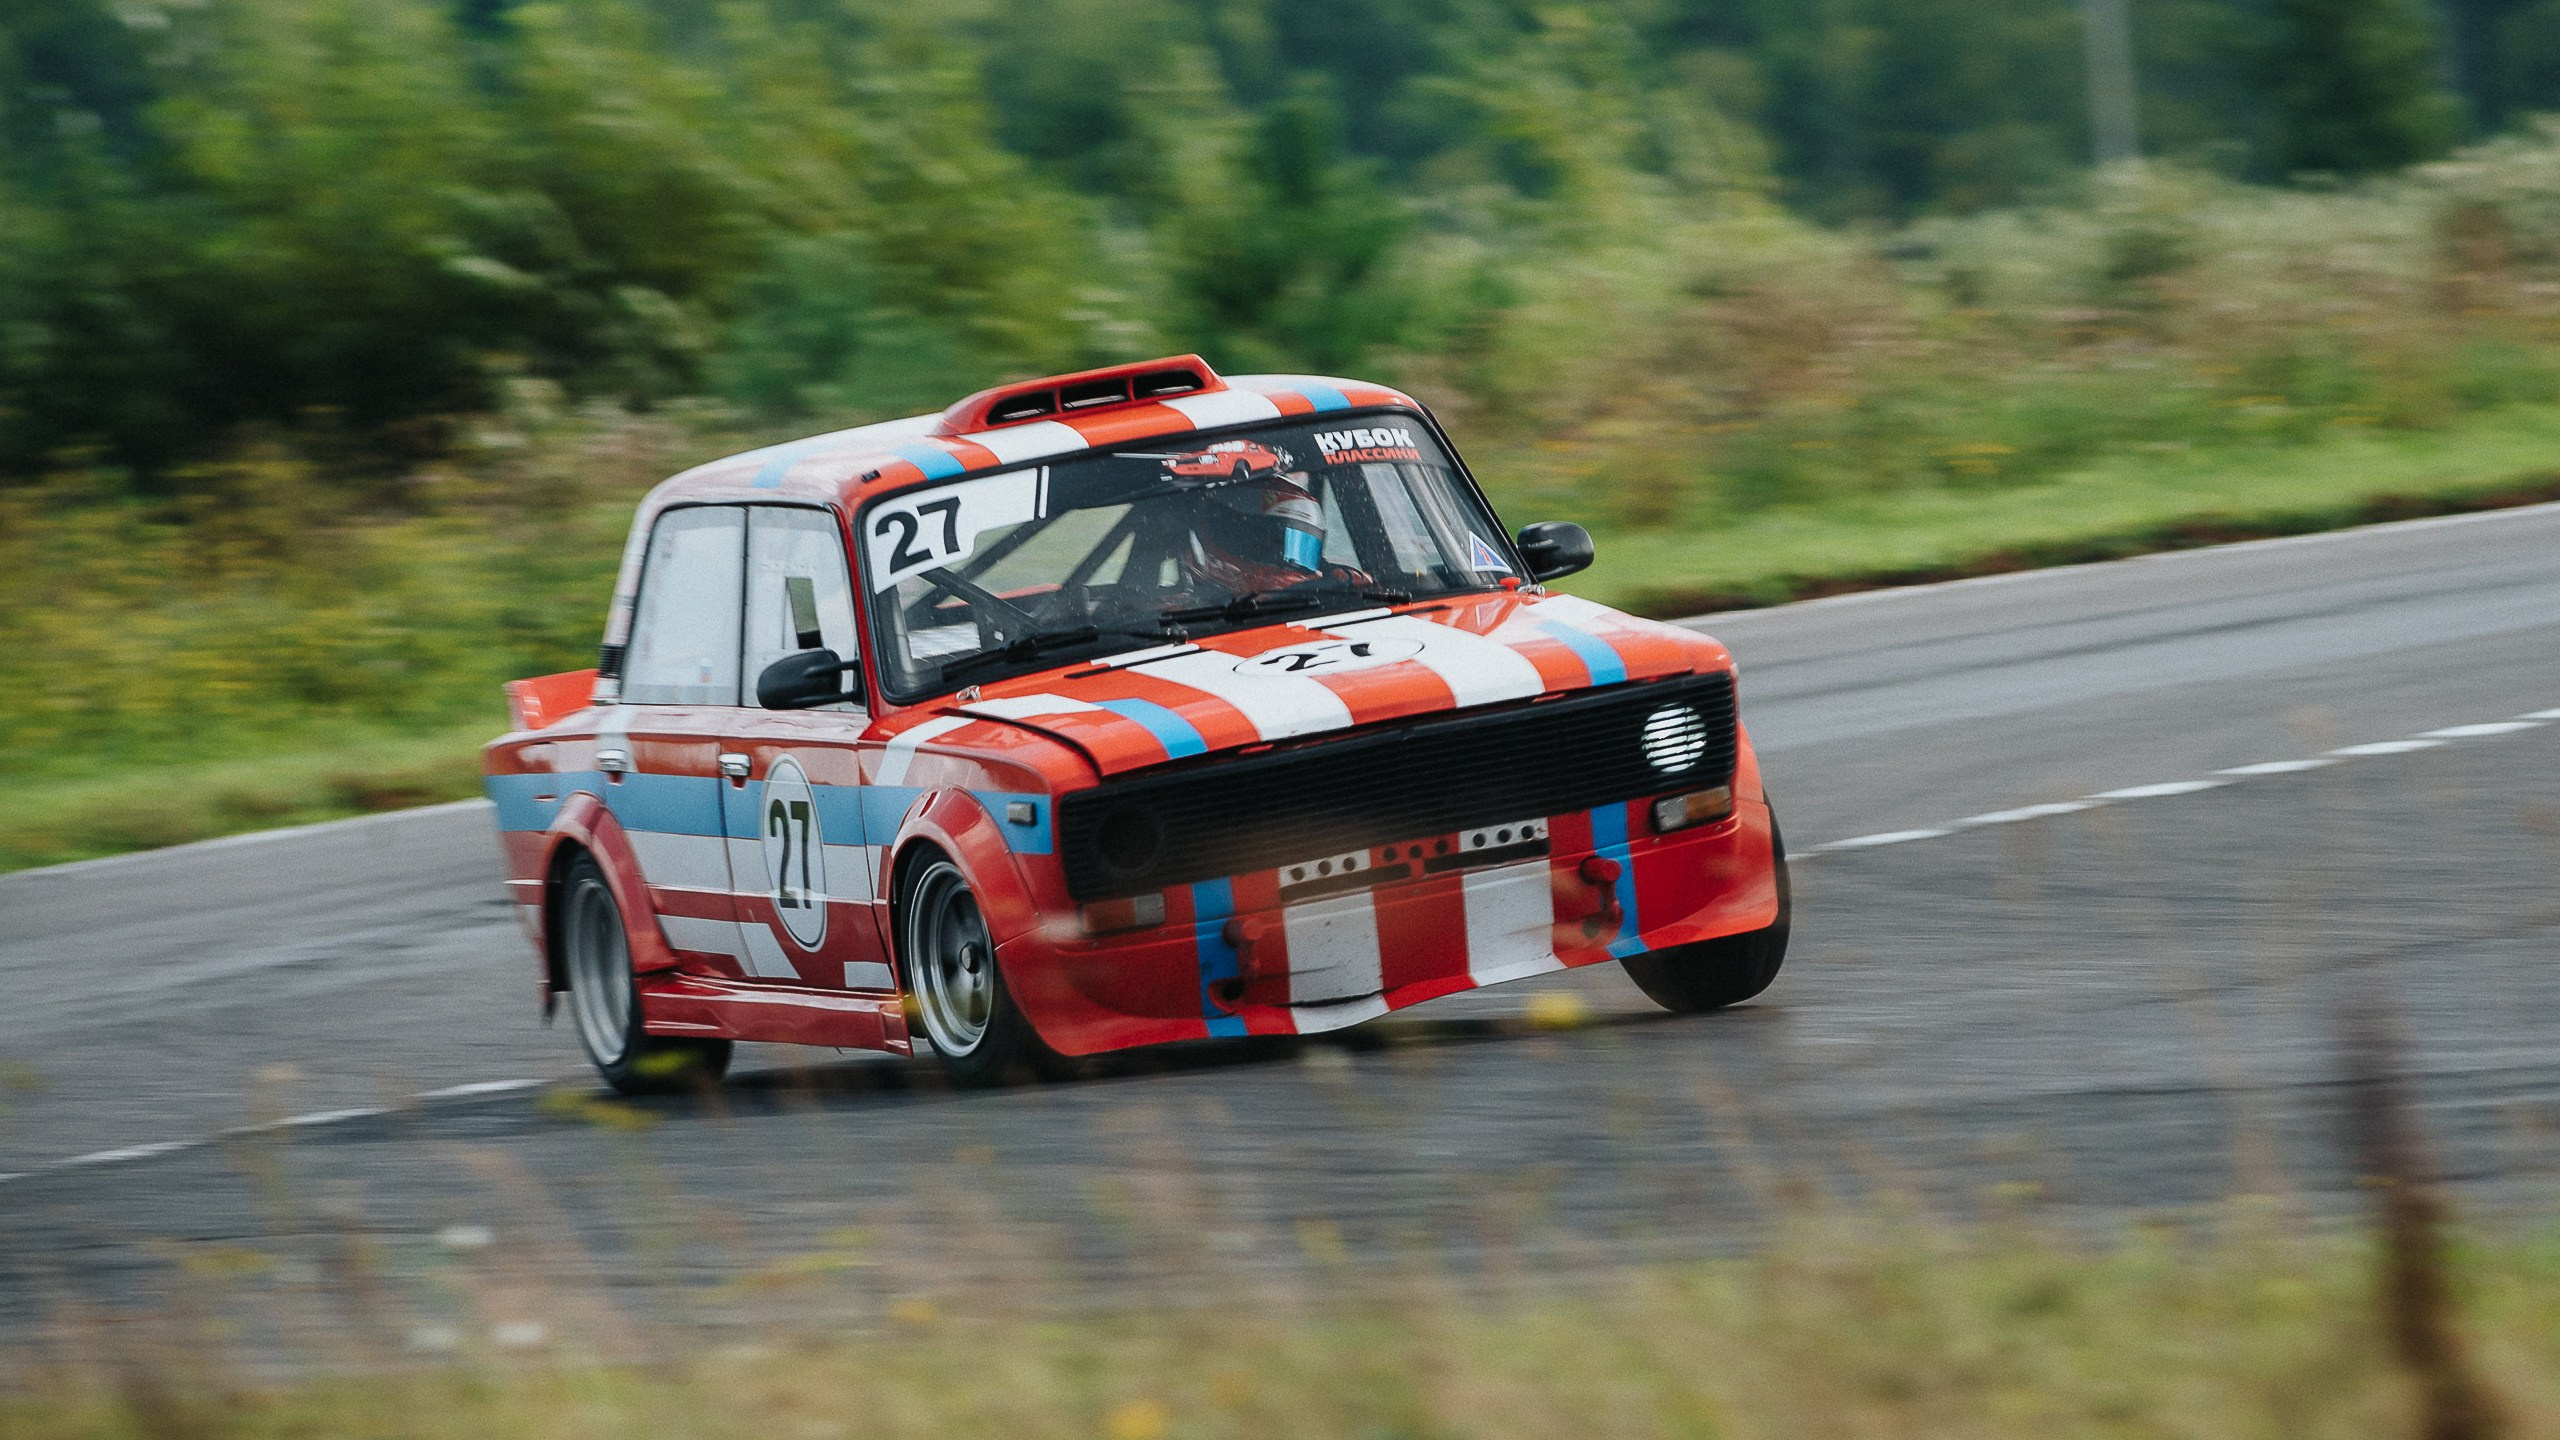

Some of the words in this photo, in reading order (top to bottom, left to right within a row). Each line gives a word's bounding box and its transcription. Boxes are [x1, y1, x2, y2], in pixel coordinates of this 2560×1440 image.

[1313, 427, 1415, 456] КУБОК
[875, 496, 961, 575] 27
[1259, 642, 1373, 672] 27
[769, 798, 812, 910] 27
